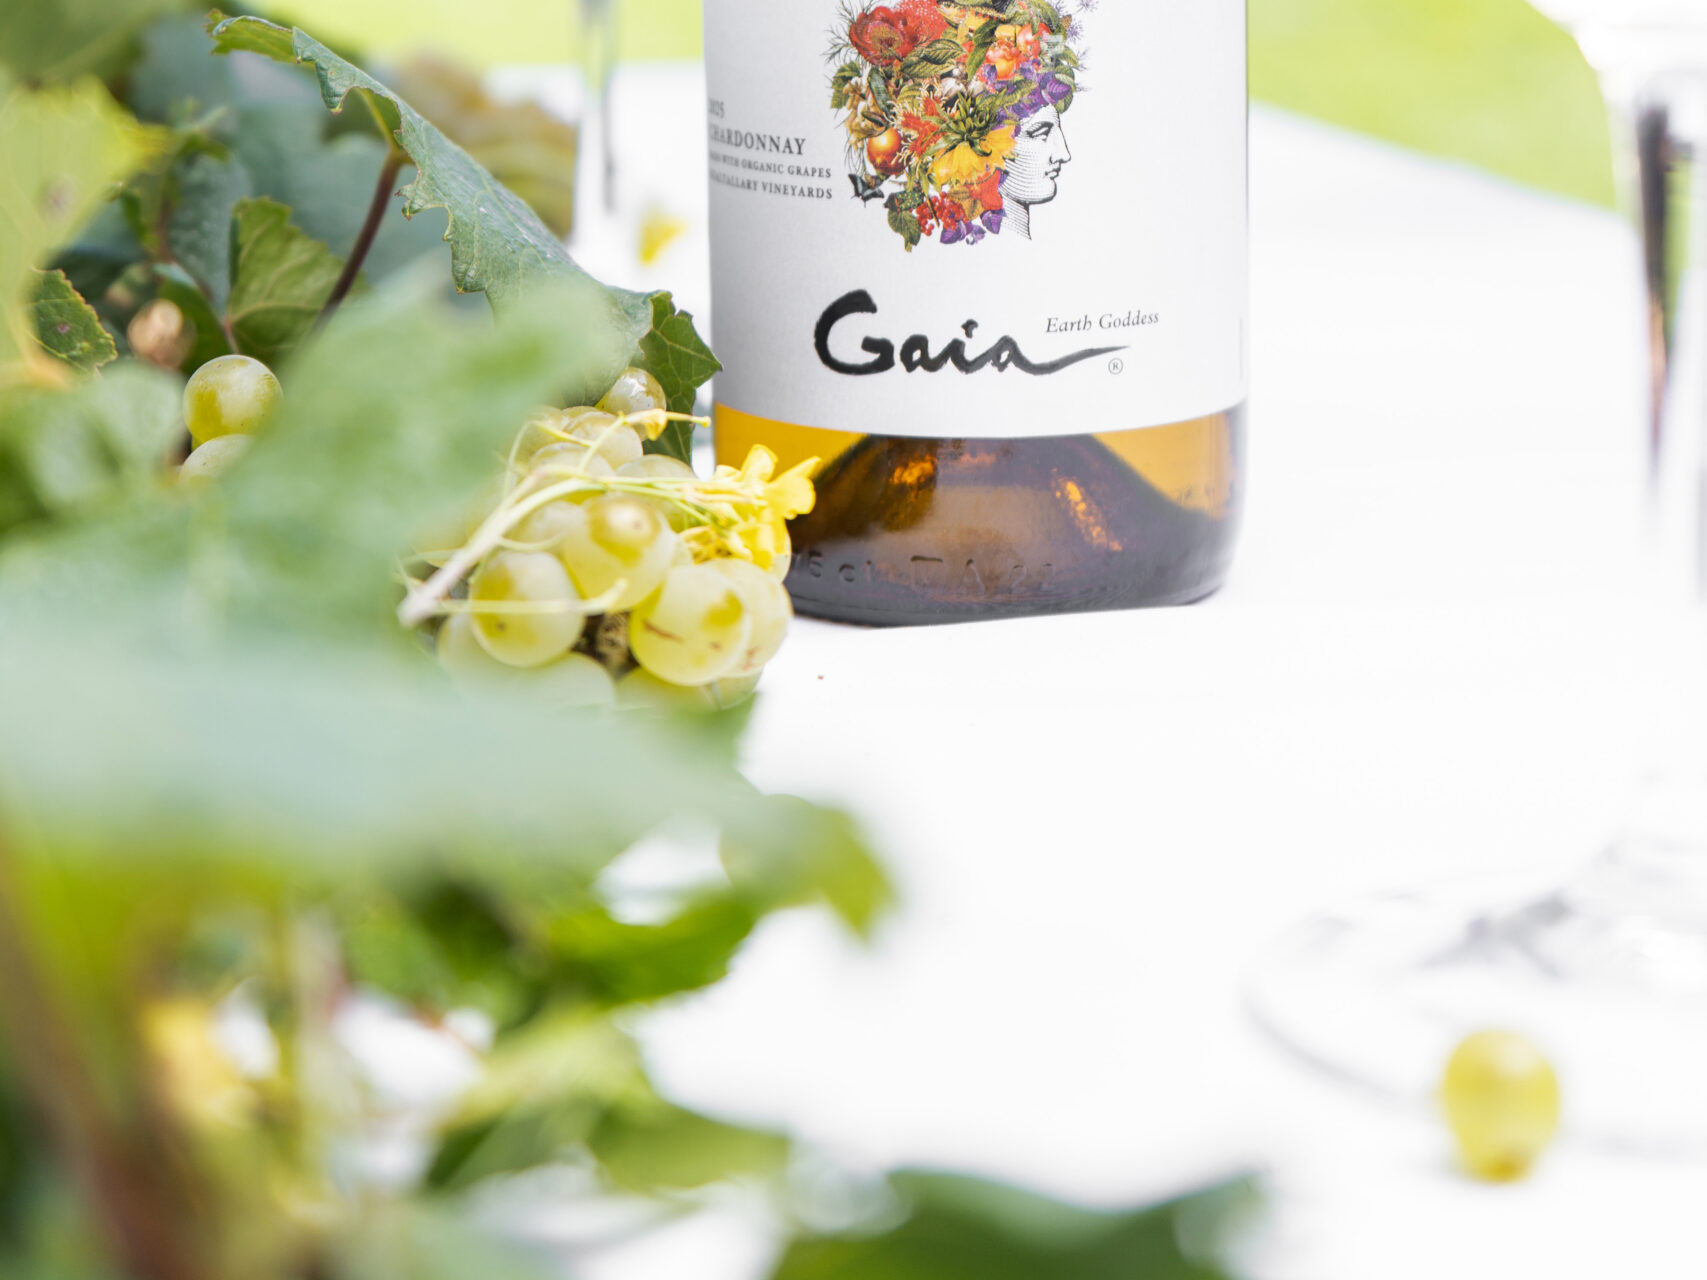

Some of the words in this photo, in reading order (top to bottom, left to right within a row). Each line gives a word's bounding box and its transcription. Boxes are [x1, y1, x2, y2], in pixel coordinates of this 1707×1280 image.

[741, 158, 784, 175] ORGANIC
[787, 164, 832, 179] GRAPES
[761, 181, 833, 200] VINEYARDS
[814, 288, 1130, 376] Gaia
[1046, 314, 1093, 334] Earth
[1099, 309, 1160, 329] Goddess
